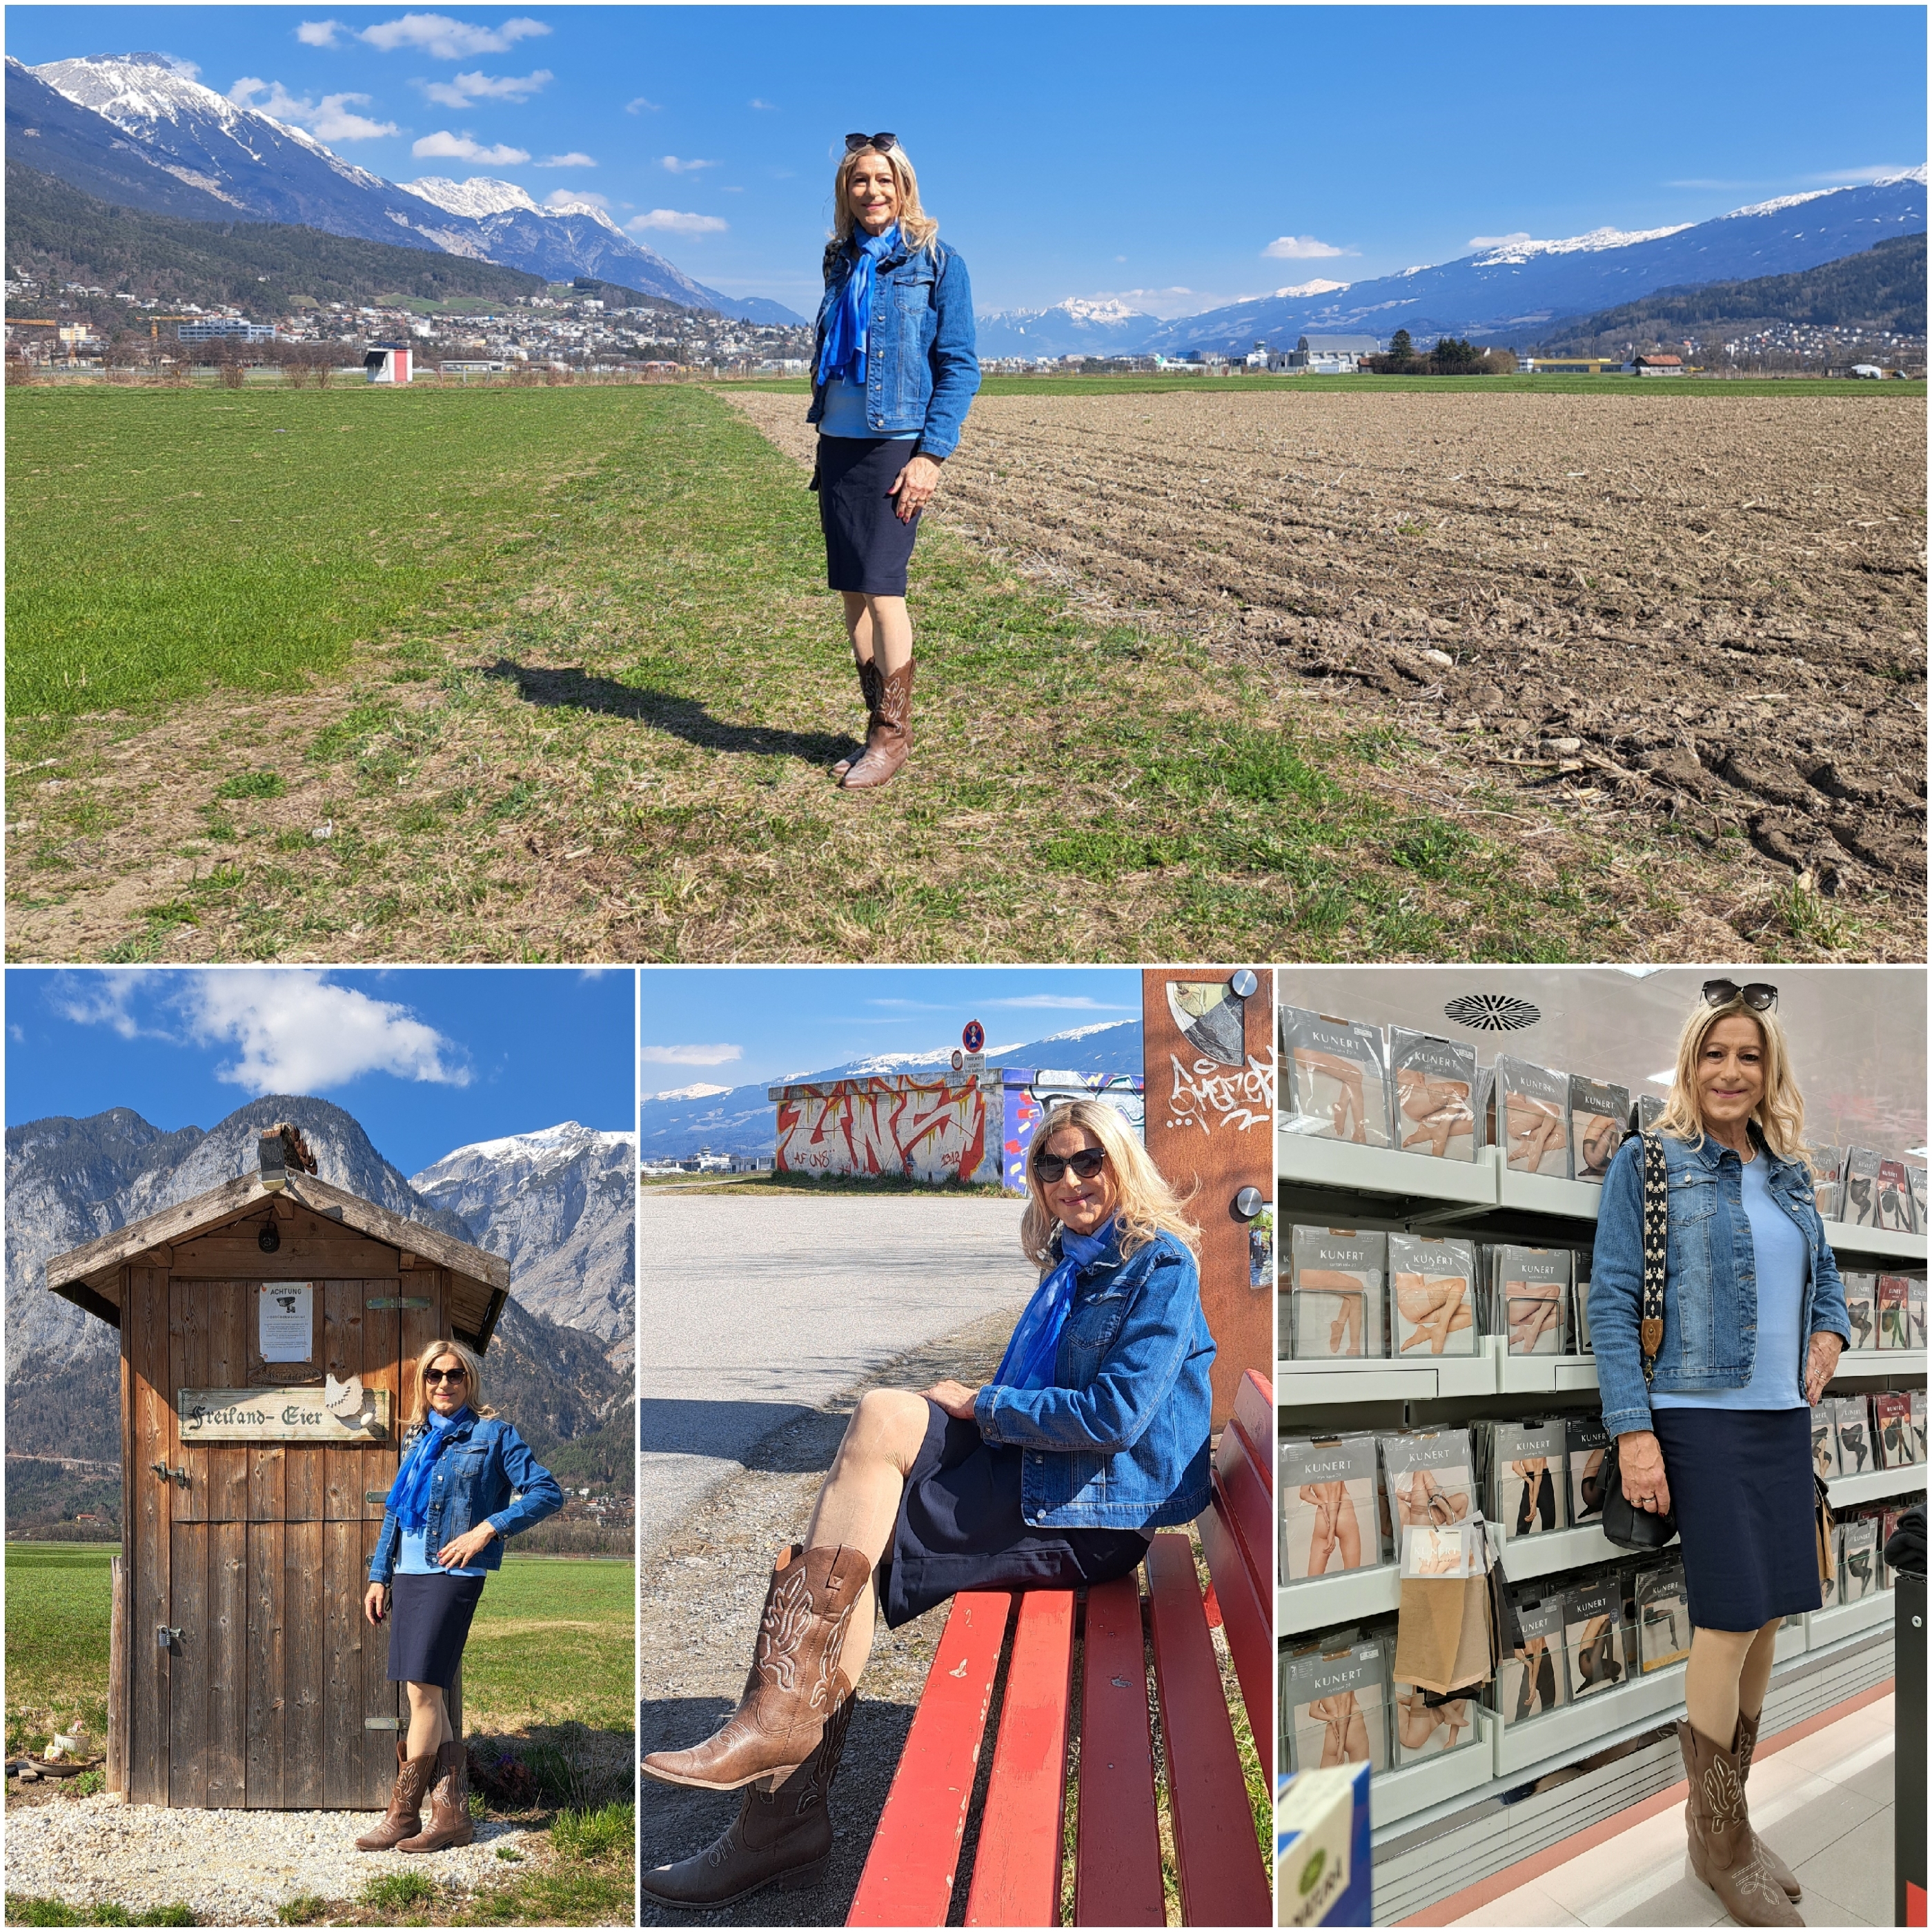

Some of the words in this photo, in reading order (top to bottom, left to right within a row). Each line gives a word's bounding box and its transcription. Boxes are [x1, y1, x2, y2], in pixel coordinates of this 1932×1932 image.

[1312, 1032, 1359, 1049] KUNERT
[1414, 1052, 1457, 1068] KUNERT
[1520, 1076, 1552, 1092] KUNERT
[1585, 1096, 1615, 1109] KUNERT
[940, 1151, 960, 1167] 1312
[1320, 1250, 1364, 1261] KUNERT
[1413, 1254, 1453, 1265] KUNERT
[1521, 1265, 1555, 1274] KUNERT
[282, 1405, 323, 1426] Eier
[1581, 1432, 1606, 1442] KUNER
[1517, 1440, 1550, 1450] KUNERT
[1409, 1450, 1449, 1462] KUNERT
[1305, 1460, 1352, 1474] KUNERT
[1414, 1546, 1458, 1555] KUNERT
[1653, 1581, 1678, 1594] KUNERT
[1577, 1598, 1606, 1613] KUNERT
[1521, 1618, 1548, 1633] UNERT
[1314, 1668, 1362, 1688] KUNERT
